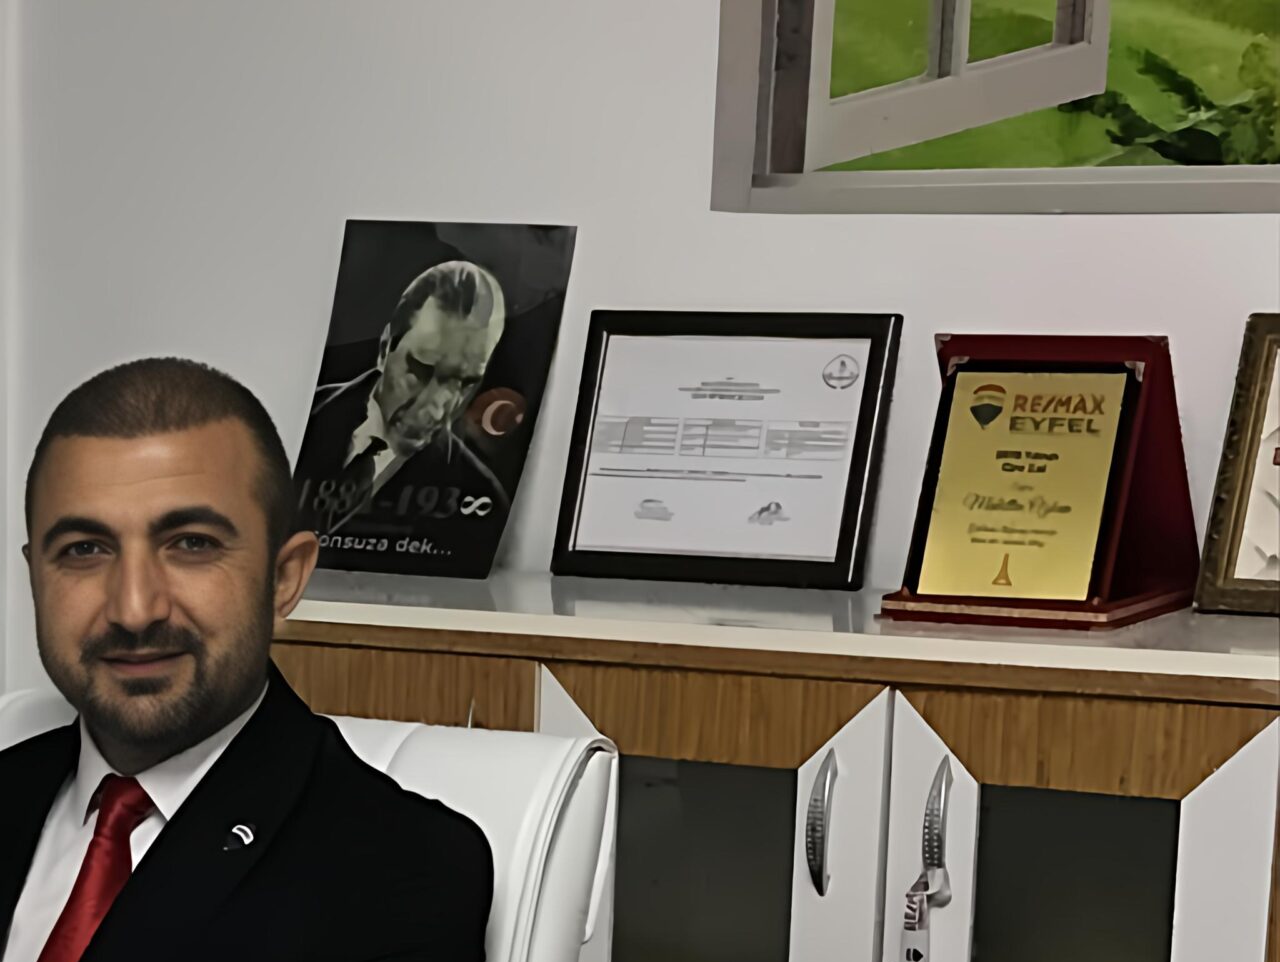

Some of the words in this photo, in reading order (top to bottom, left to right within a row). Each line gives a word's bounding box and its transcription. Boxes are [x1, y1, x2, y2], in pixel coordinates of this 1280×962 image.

[1013, 393, 1105, 415] RE/MAX
[1009, 416, 1101, 434] EYFEL
[315, 530, 389, 551] onsuza
